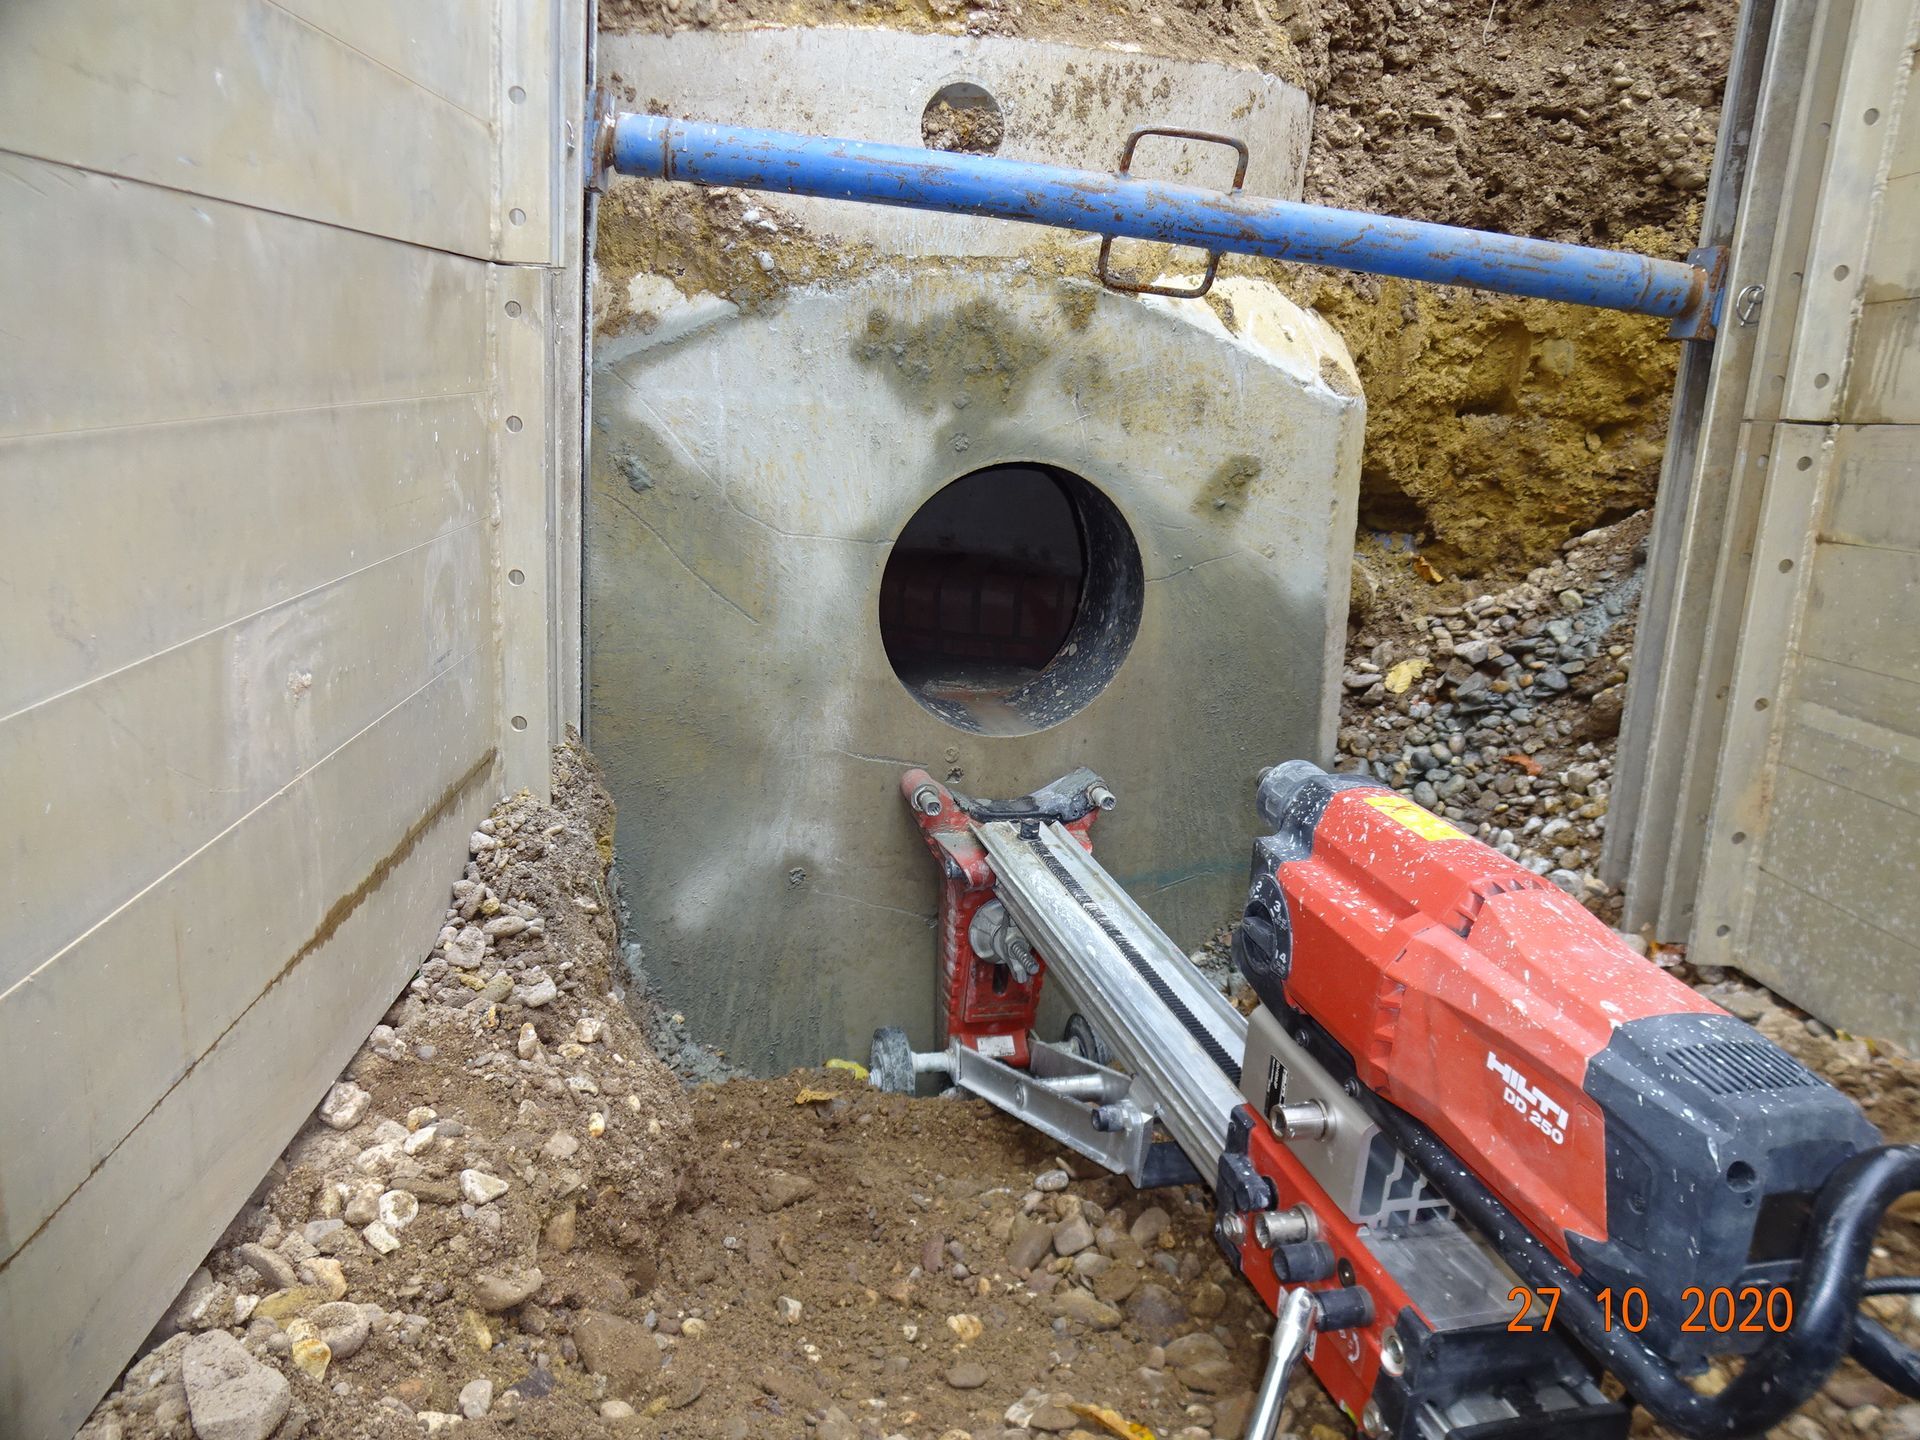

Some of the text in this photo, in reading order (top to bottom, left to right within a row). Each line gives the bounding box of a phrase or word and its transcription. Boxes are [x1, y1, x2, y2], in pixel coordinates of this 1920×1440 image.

[1486, 1051, 1569, 1130] HILTI
[1503, 1086, 1564, 1145] DD 250
